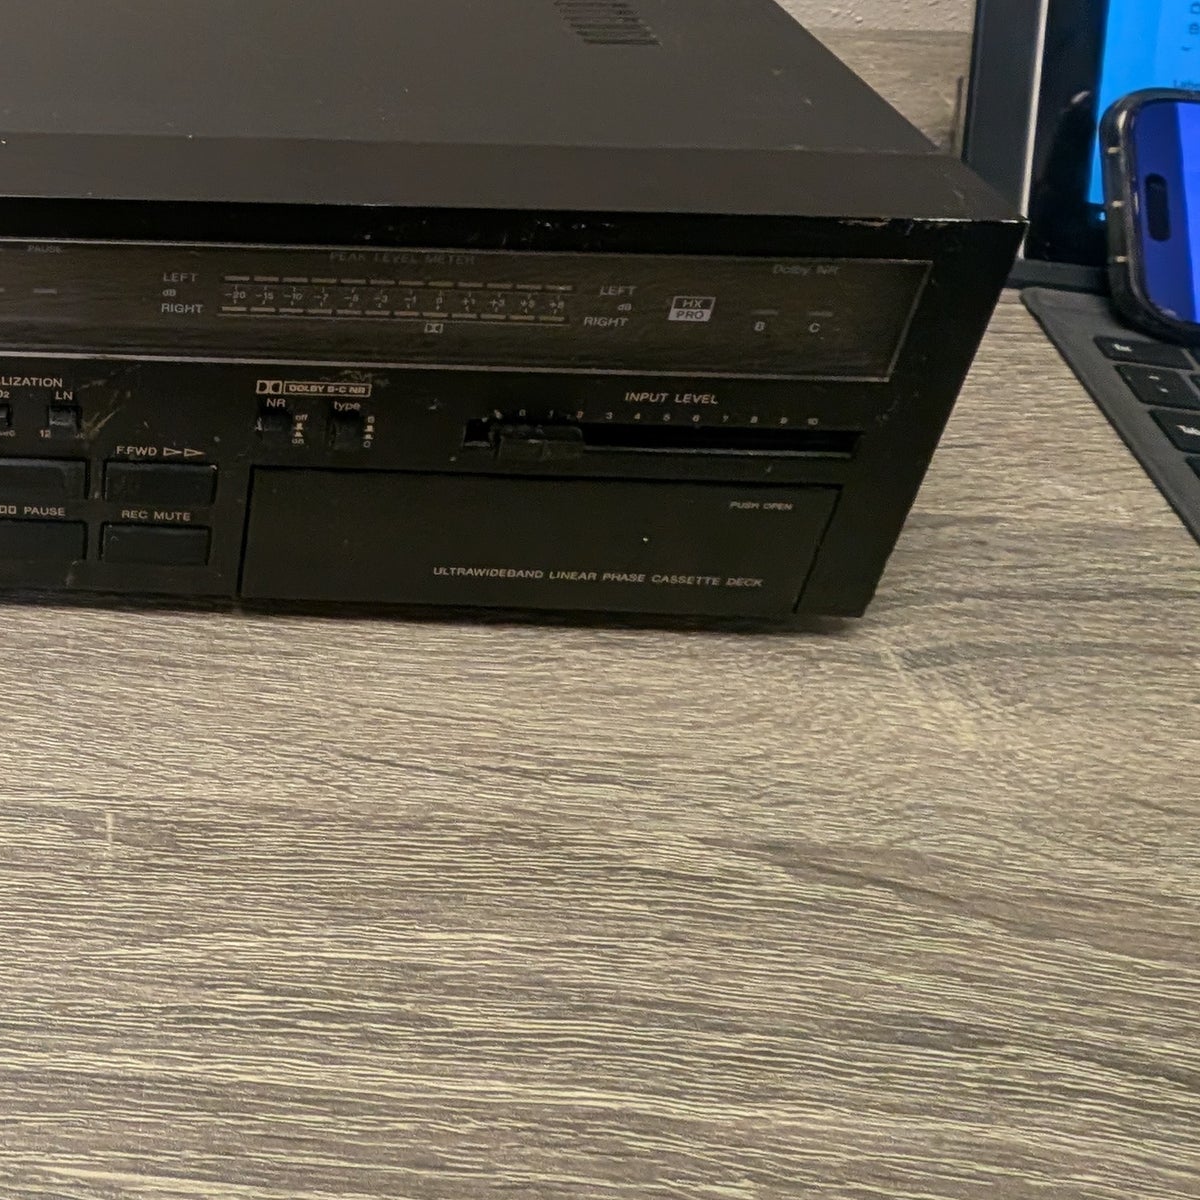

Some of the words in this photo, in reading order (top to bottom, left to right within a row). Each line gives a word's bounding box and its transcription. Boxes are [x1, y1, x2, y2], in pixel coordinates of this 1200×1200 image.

[163, 273, 197, 282] LEFT
[599, 285, 637, 296] LEFT
[161, 303, 203, 313] RIGHT
[682, 299, 704, 308] HX
[675, 310, 705, 320] PRO
[583, 317, 629, 327] RIGHT
[288, 384, 325, 393] DOLBY
[55, 391, 73, 400] LN
[624, 391, 668, 403] INPUT
[674, 393, 719, 405] LEVEL
[266, 398, 286, 408] NR
[333, 401, 361, 411] type
[729, 500, 759, 510] PUSH
[23, 506, 66, 517] PAUSE
[121, 509, 148, 519] REC
[153, 510, 191, 521] MUTE
[433, 566, 544, 580] ULTRAWIDEBAND
[549, 571, 597, 582] LINEAR
[602, 572, 646, 583] PHASE
[651, 573, 720, 586] CASSETTE
[725, 577, 764, 588] DECK
